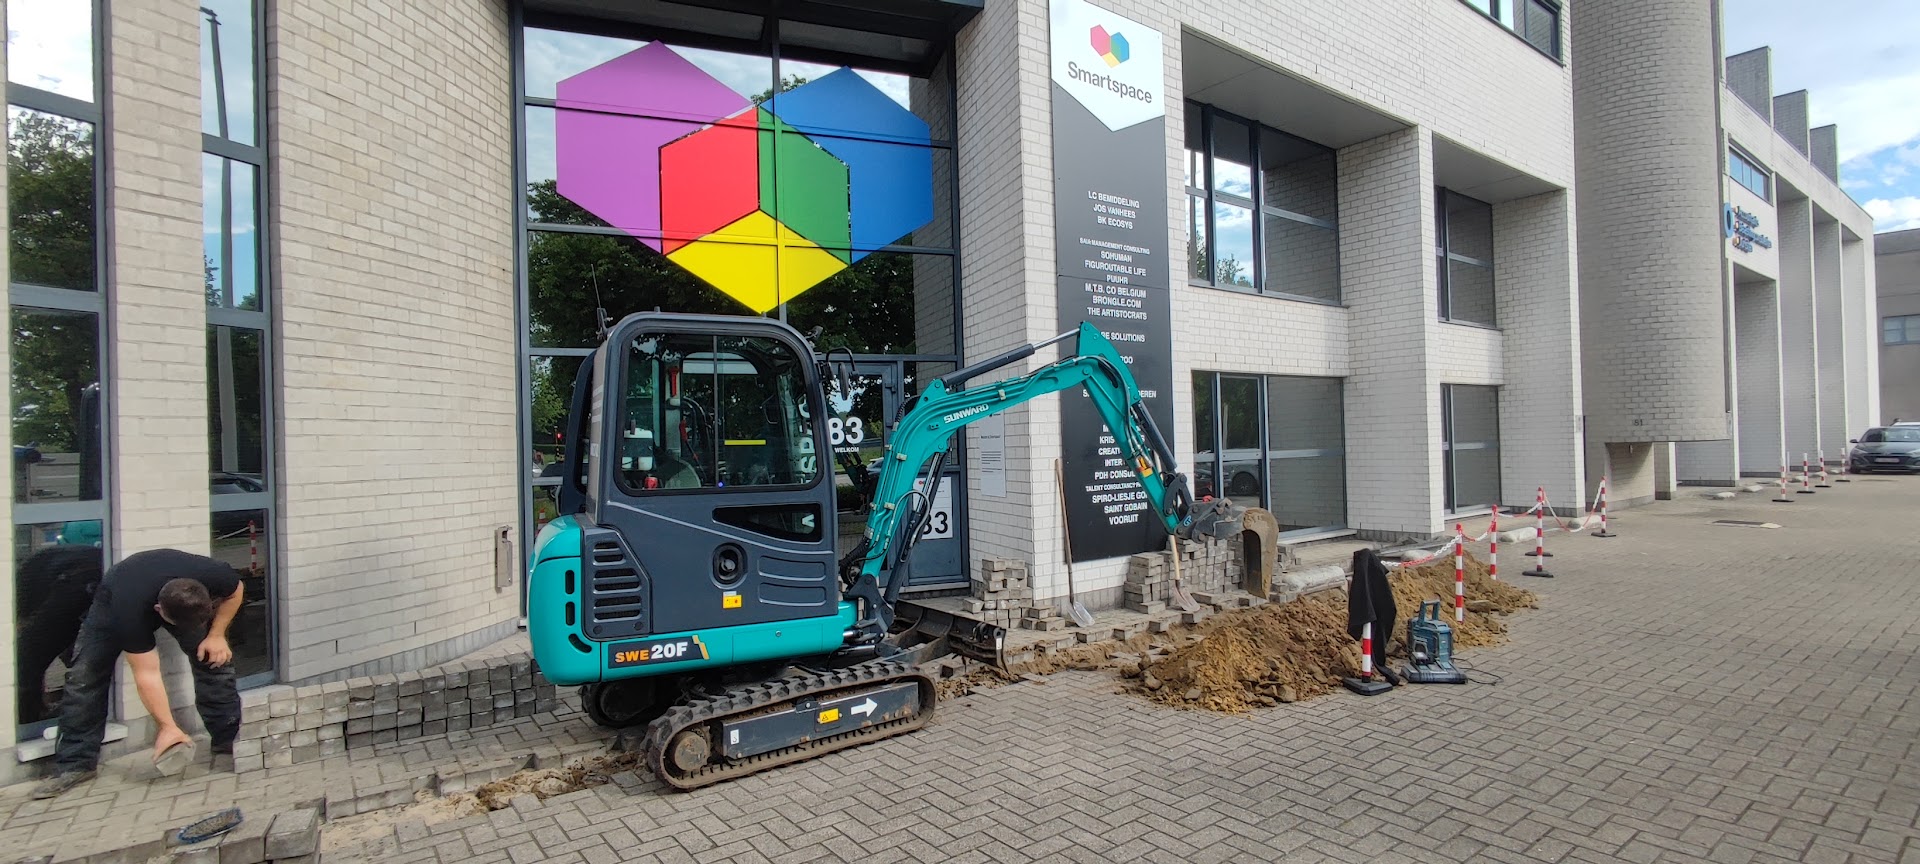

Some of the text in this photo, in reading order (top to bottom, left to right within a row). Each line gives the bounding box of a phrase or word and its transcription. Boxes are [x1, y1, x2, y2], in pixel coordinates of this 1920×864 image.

[1067, 62, 1151, 103] Smartspace
[1088, 190, 1139, 208] LC BEMIDDELING
[1093, 204, 1135, 218] JOS VANHEES
[1107, 218, 1132, 229] ECOSYS
[1101, 252, 1131, 262] SOHUMAN
[1085, 260, 1146, 276] FIGUROUTABLE LIFE
[1106, 276, 1128, 284] PUUHR
[1085, 284, 1104, 292] M.T.B.
[1117, 288, 1146, 298] BELGIUM
[1092, 296, 1141, 308] BRONGLE.COM
[1101, 310, 1147, 320] ARTISTOCRATS
[1111, 332, 1145, 342] SOLUTIONS
[943, 404, 989, 423] SUNWARD
[828, 416, 864, 445] 83
[1104, 502, 1147, 513] SAINT GOBAIN
[1108, 514, 1138, 525] VOORUIT
